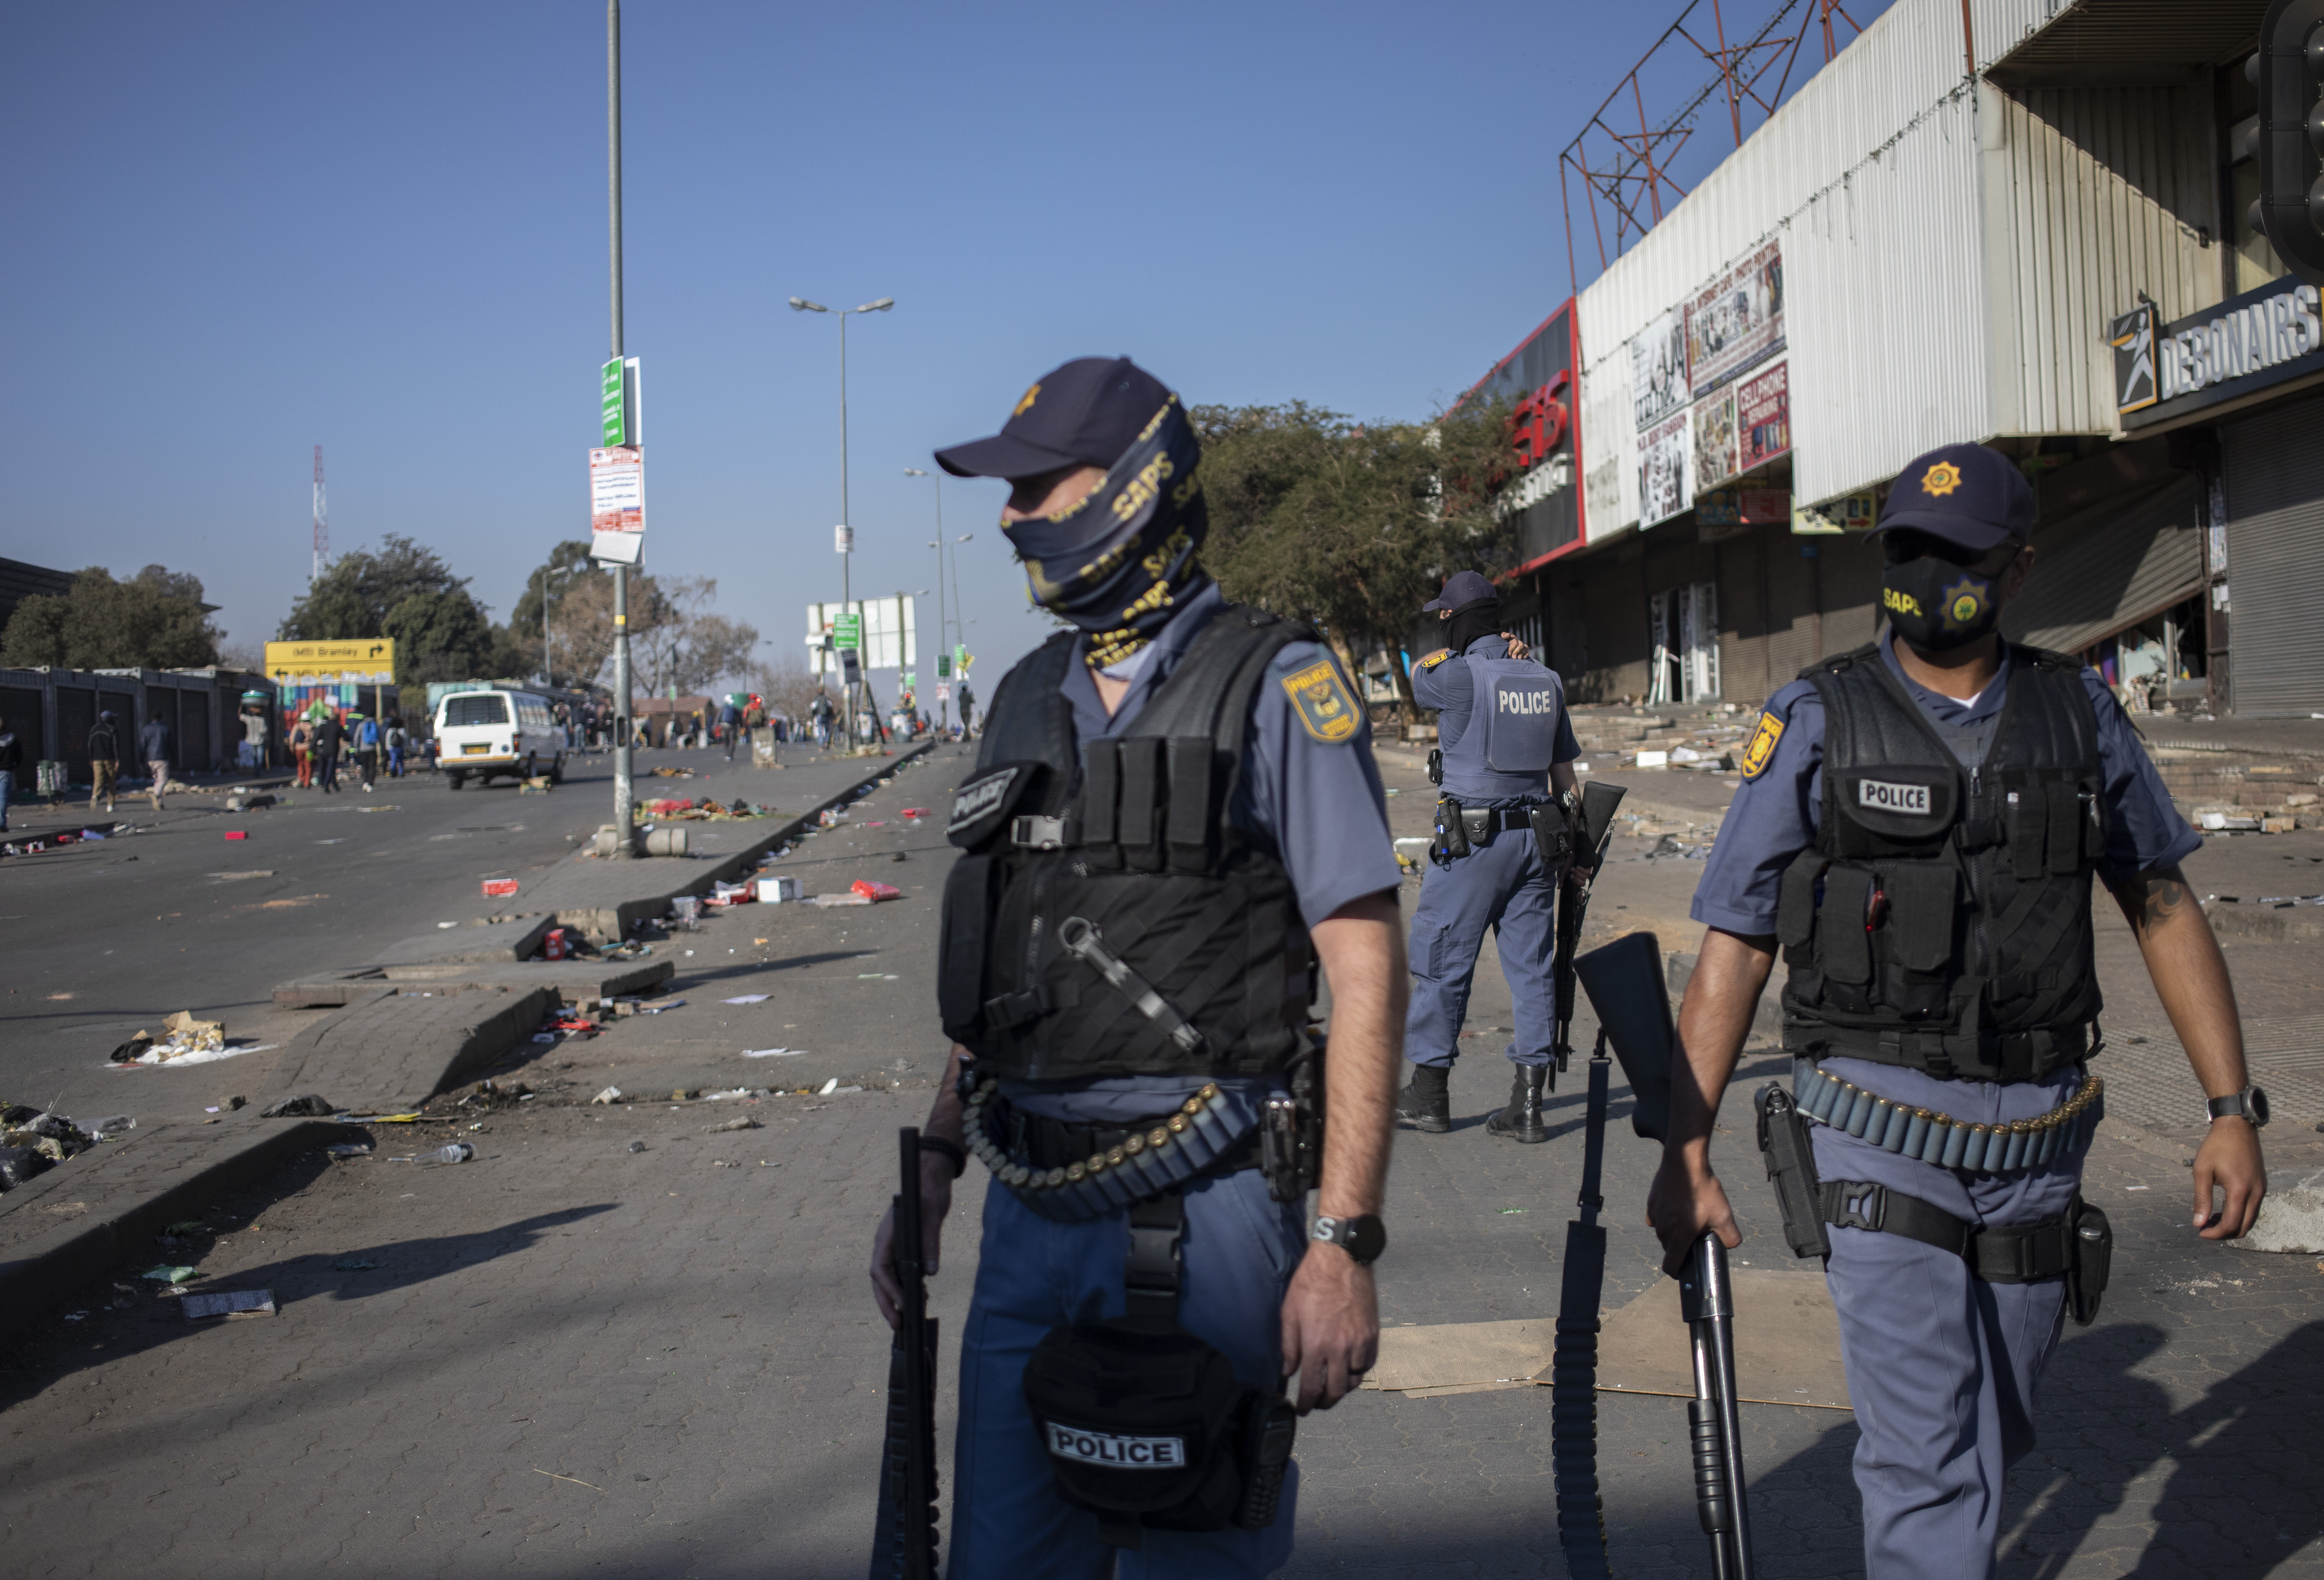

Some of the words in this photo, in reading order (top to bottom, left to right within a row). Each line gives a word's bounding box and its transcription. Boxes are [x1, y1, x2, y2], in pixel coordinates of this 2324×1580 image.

[1735, 258, 1752, 279] PHOTO
[1754, 237, 1779, 265] PRINTING
[2160, 285, 2320, 400] DEBONAIRS
[1740, 366, 1786, 411] CELLPHONE
[1748, 395, 1779, 425] REPAIRING
[1112, 450, 1174, 521] SAPS
[1883, 587, 1923, 617] SAPS
[318, 646, 358, 658] Bramley
[1289, 664, 1332, 693] POLICE
[1499, 690, 1551, 714] POLICE
[1762, 717, 1781, 736] POLICE
[1866, 783, 1925, 808] POLICE
[1055, 1431, 1174, 1462] POLICE
